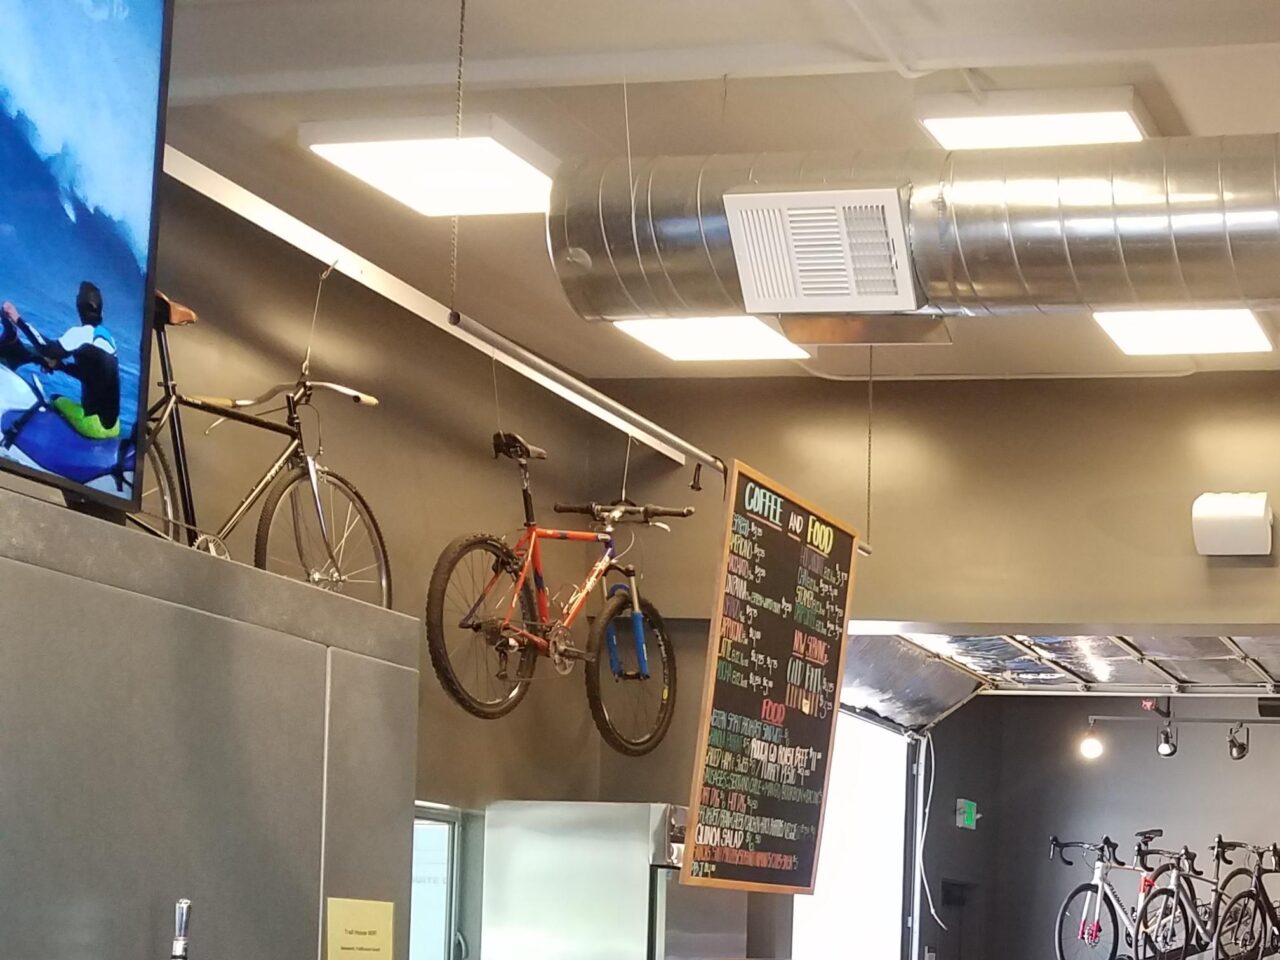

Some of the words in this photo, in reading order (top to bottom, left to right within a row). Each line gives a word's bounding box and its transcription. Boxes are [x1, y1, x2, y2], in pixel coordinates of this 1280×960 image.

[744, 482, 784, 526] COFFEE
[788, 511, 803, 534] AND
[806, 515, 834, 554] FOOD
[761, 698, 786, 724] FOOD
[695, 823, 721, 846] QUINOA
[720, 827, 745, 849] SALAD
